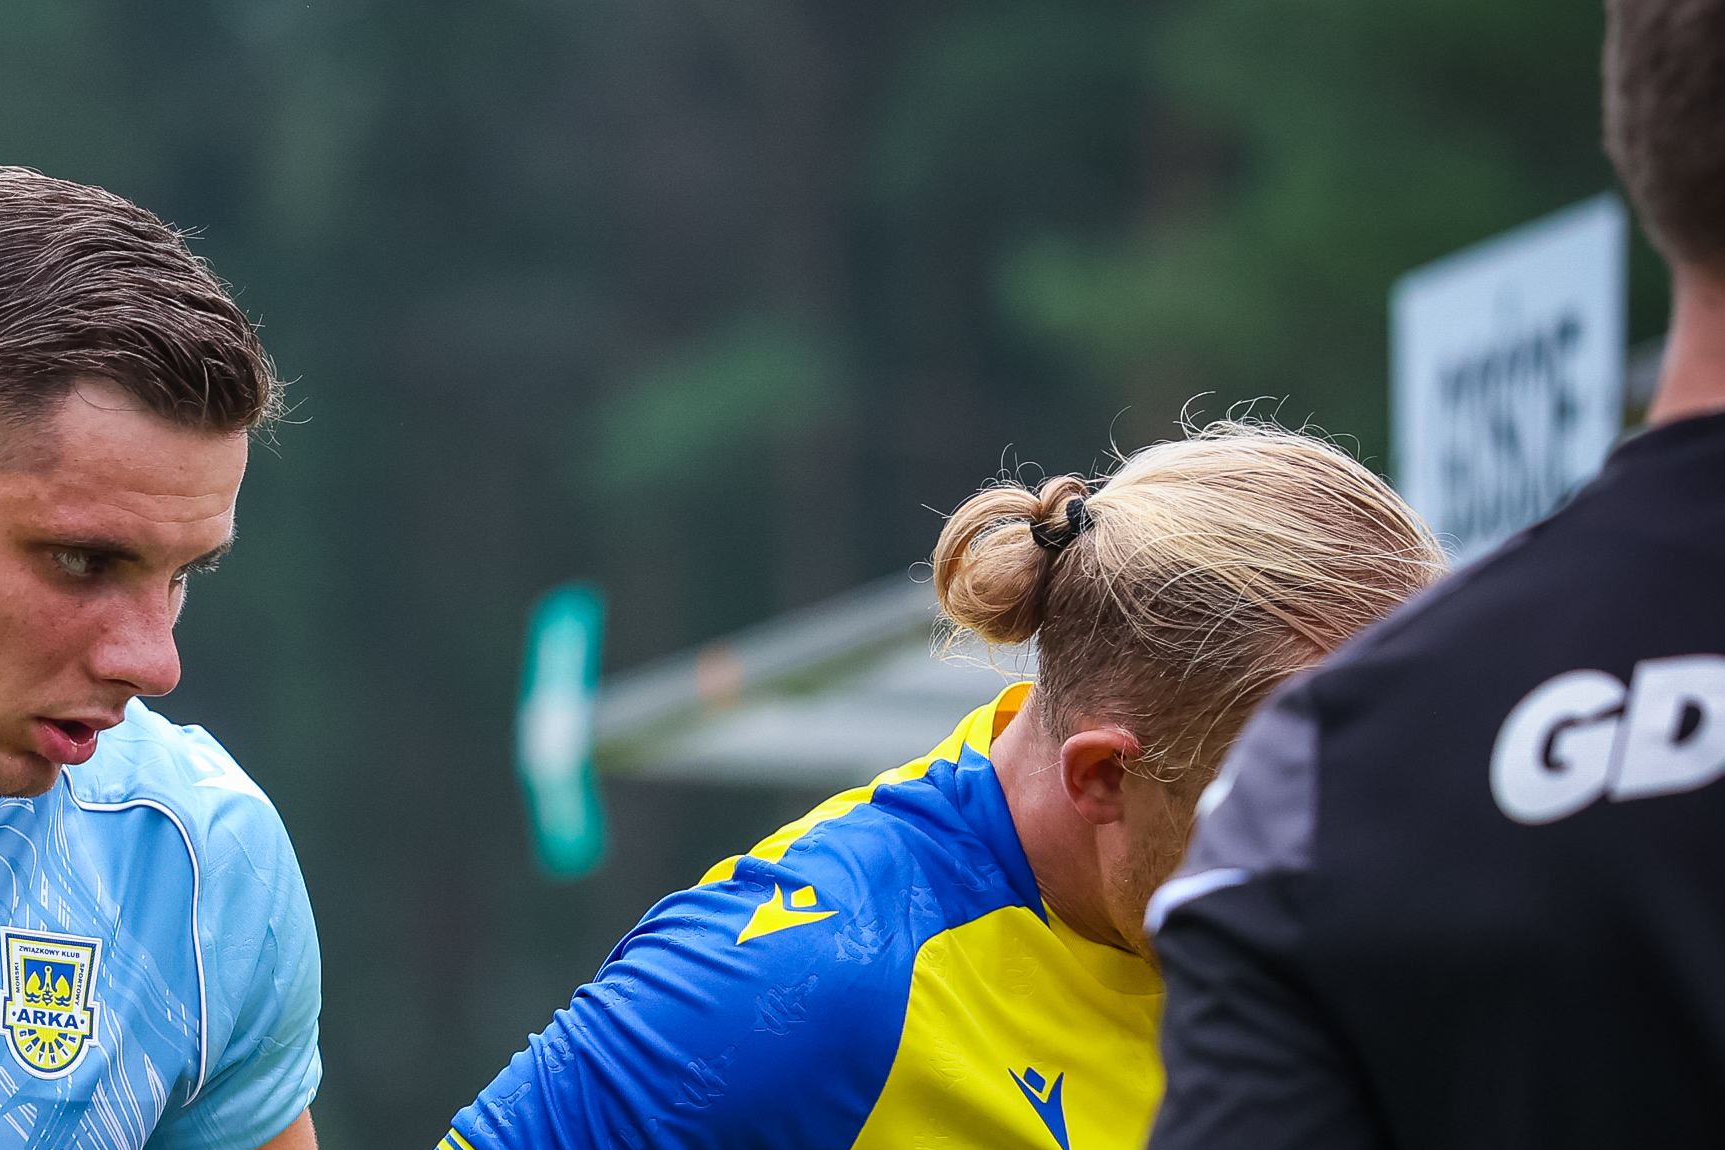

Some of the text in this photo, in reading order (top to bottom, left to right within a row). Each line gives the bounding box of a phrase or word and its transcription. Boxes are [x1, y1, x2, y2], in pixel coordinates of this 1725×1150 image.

[61, 951, 80, 959] KLUB
[74, 963, 85, 1006] SPORTOWY
[16, 1008, 79, 1030] ARKA
